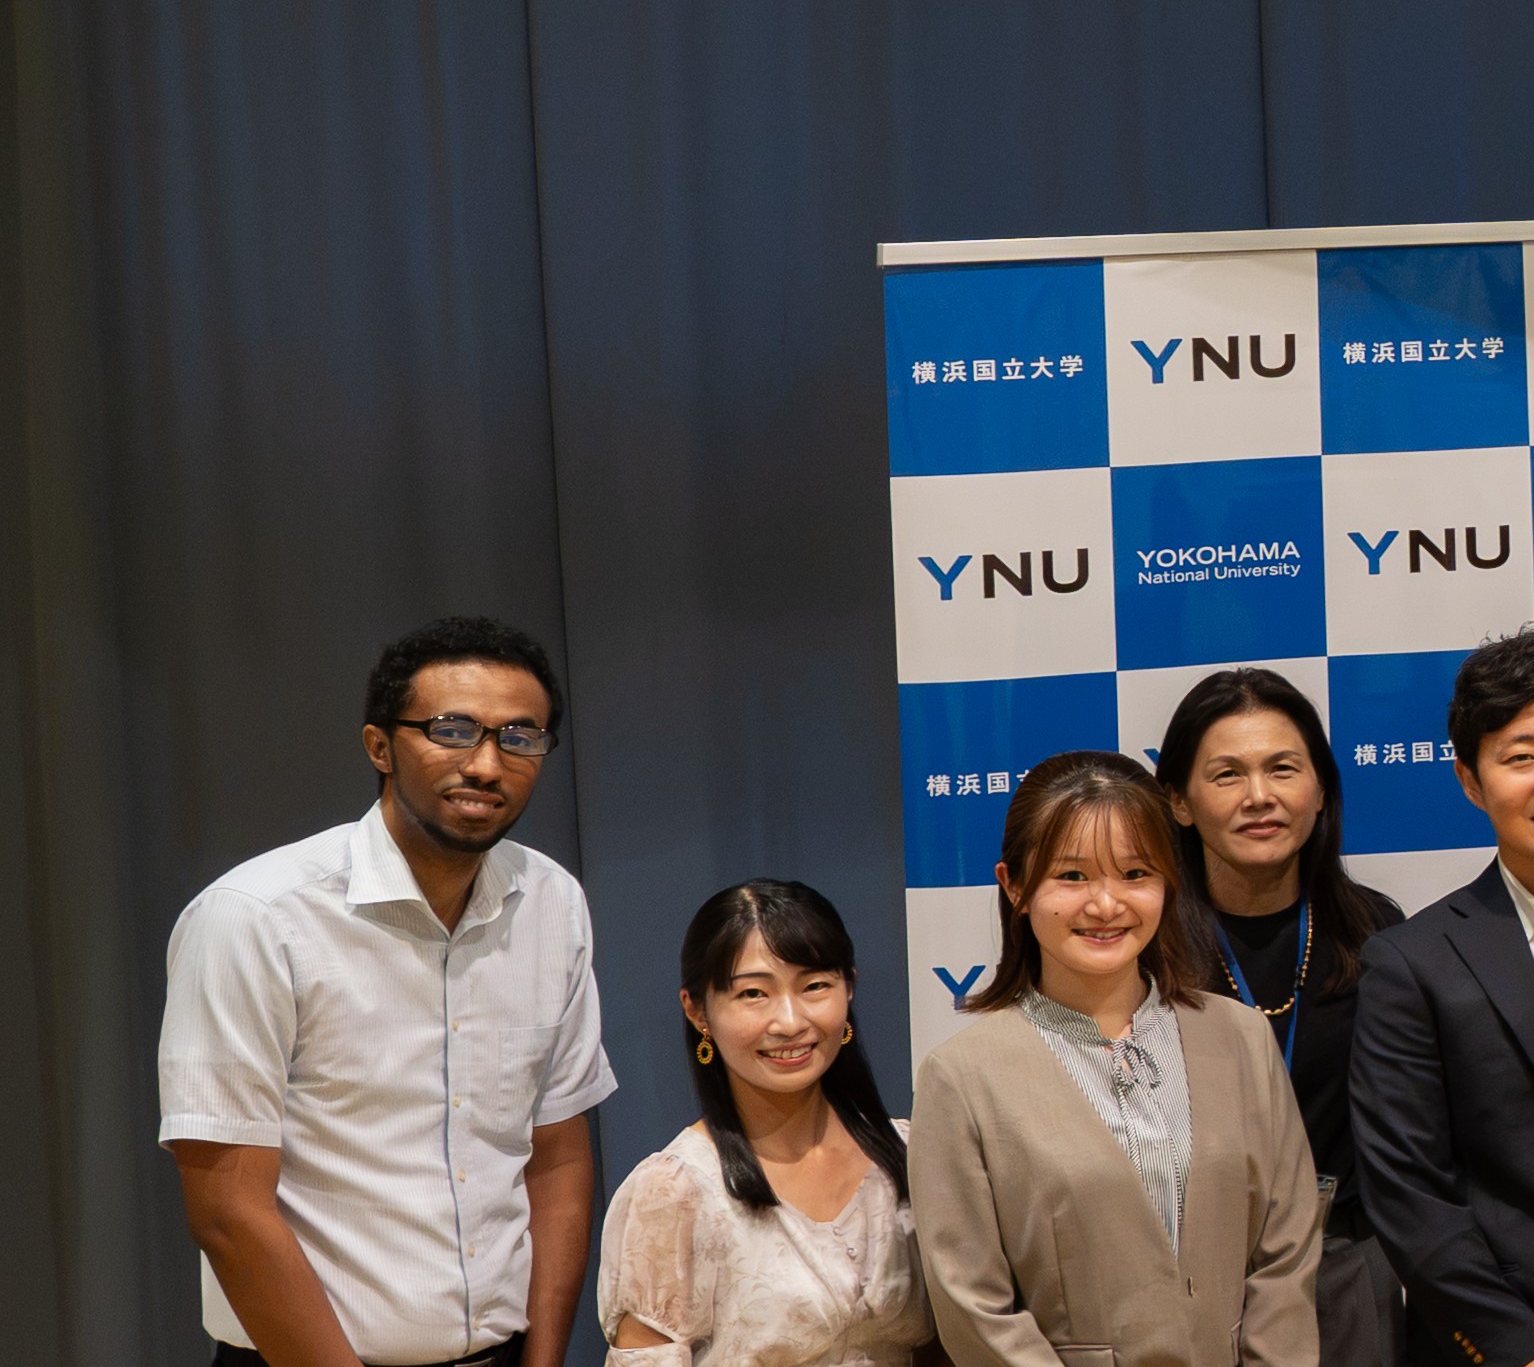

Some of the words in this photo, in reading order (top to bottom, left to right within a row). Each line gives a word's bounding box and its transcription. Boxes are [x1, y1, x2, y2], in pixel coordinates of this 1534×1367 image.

[1131, 333, 1296, 383] YNU
[1343, 338, 1504, 365] 横浜国立大学
[912, 354, 1083, 383] 横浜国立大学
[1137, 541, 1300, 567] YOKOHAMA
[1348, 525, 1511, 575] YNU
[918, 548, 1089, 600] YNU
[1138, 567, 1209, 585] National
[1215, 562, 1301, 582] University
[1354, 740, 1457, 765] 横浜国立
[927, 770, 1029, 796] 横浜国
